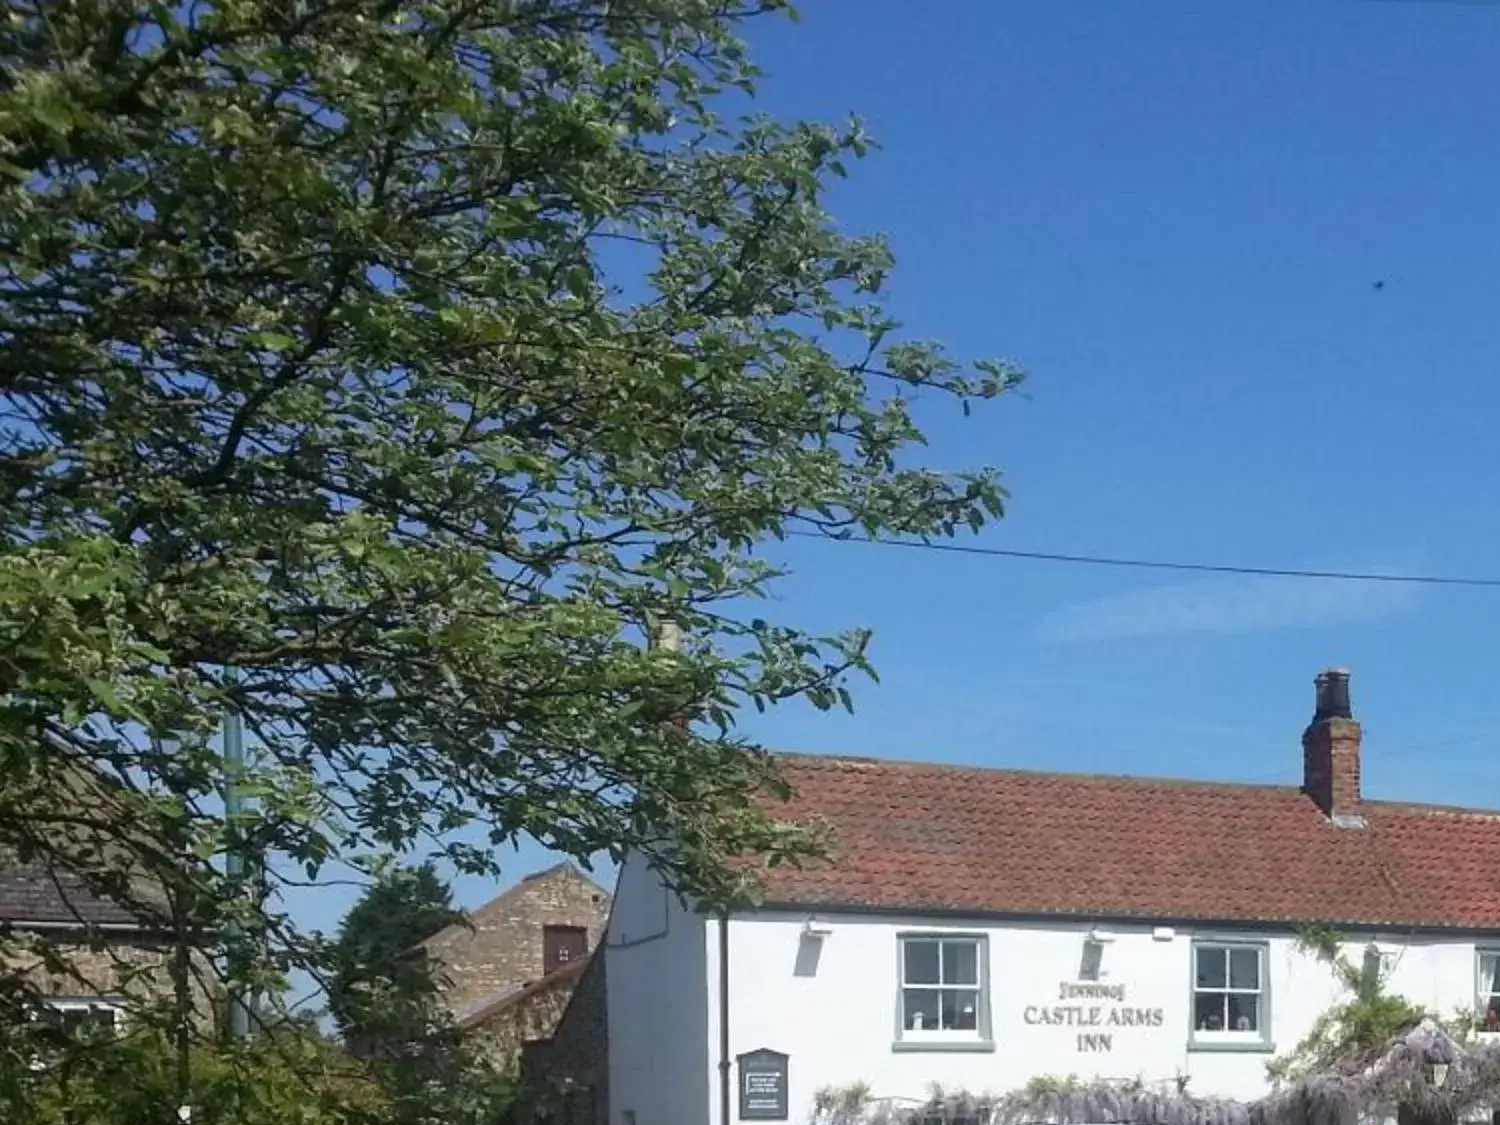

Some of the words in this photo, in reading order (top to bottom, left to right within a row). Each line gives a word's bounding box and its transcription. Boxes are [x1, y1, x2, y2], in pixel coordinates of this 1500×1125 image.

[1023, 1005, 1101, 1026] CASTLE
[1106, 1007, 1164, 1026] ARMS
[1077, 1033, 1112, 1052] INN
